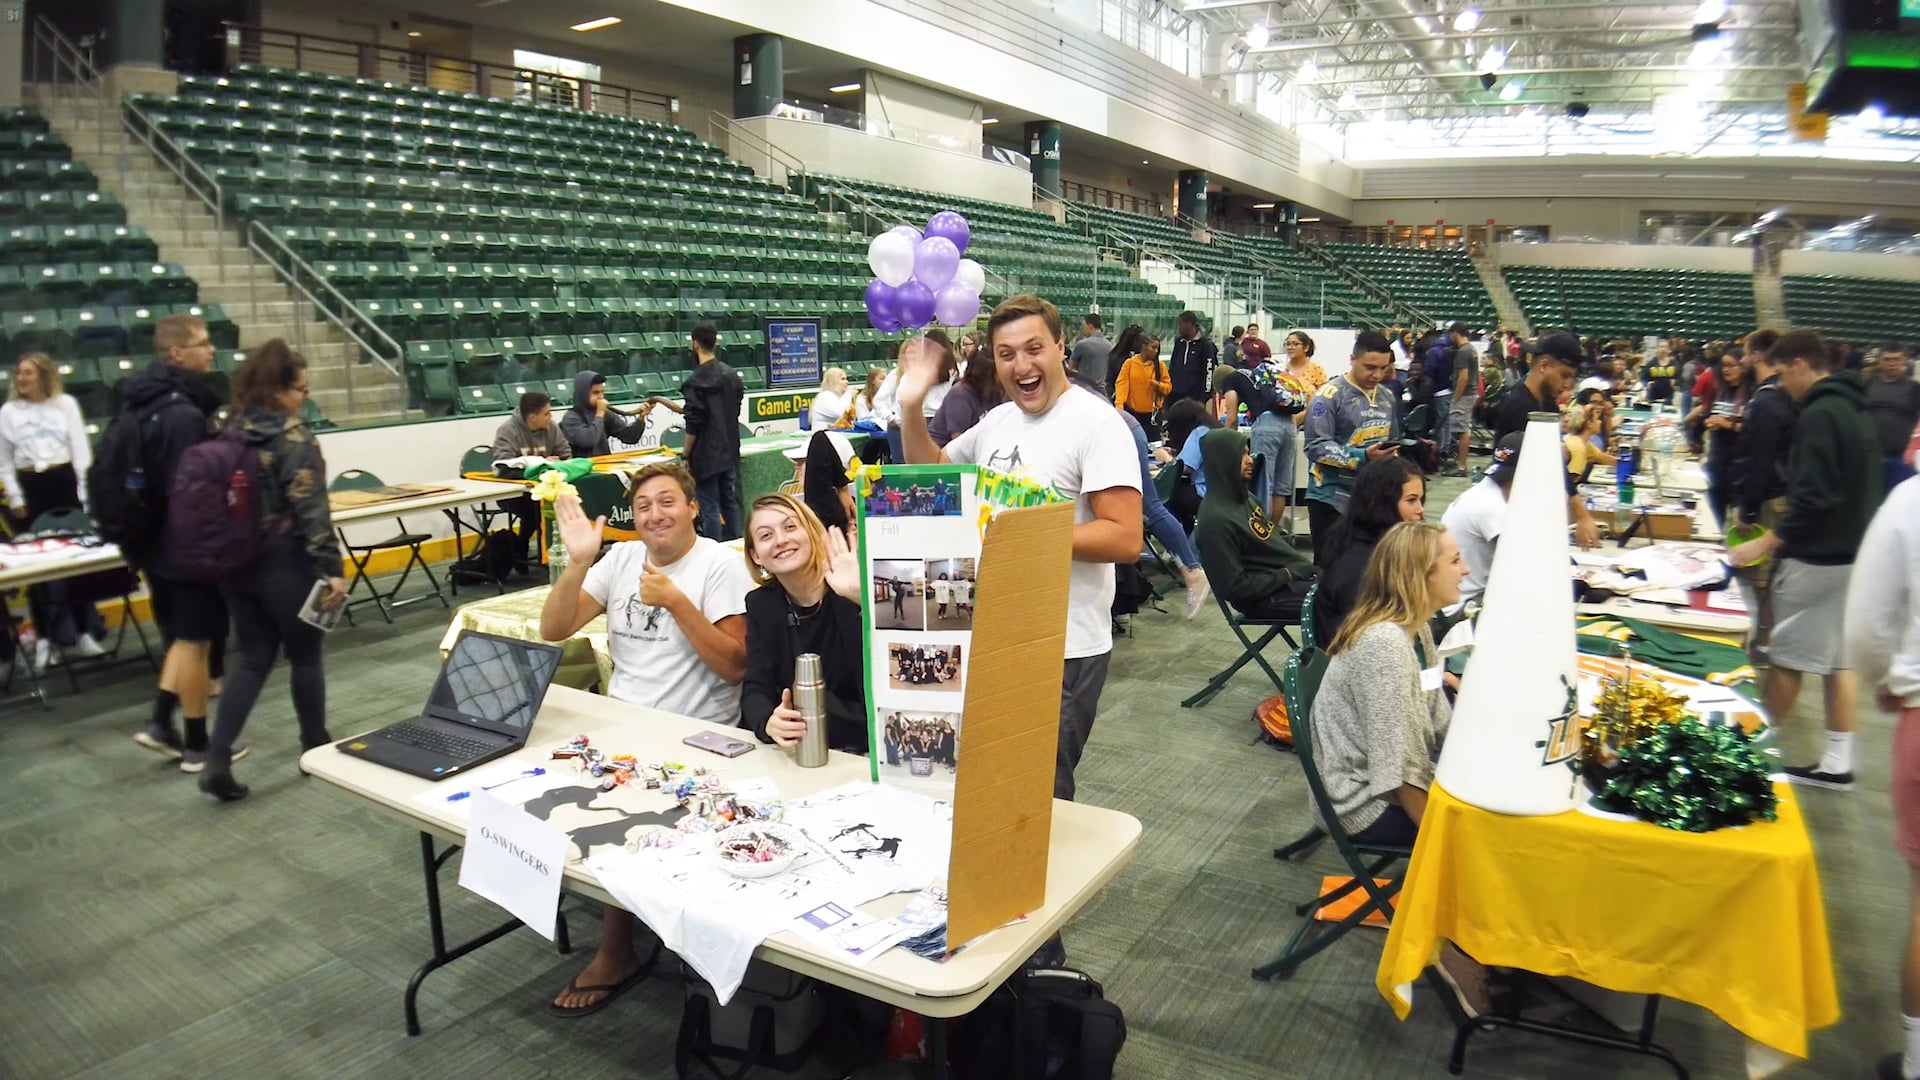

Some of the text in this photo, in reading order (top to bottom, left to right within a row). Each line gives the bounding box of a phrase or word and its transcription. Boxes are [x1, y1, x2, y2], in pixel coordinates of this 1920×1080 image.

[7, 10, 19, 21] 51
[757, 394, 815, 416] Game Day
[881, 521, 899, 534] Fall
[480, 826, 549, 877] O-SWINGERS
